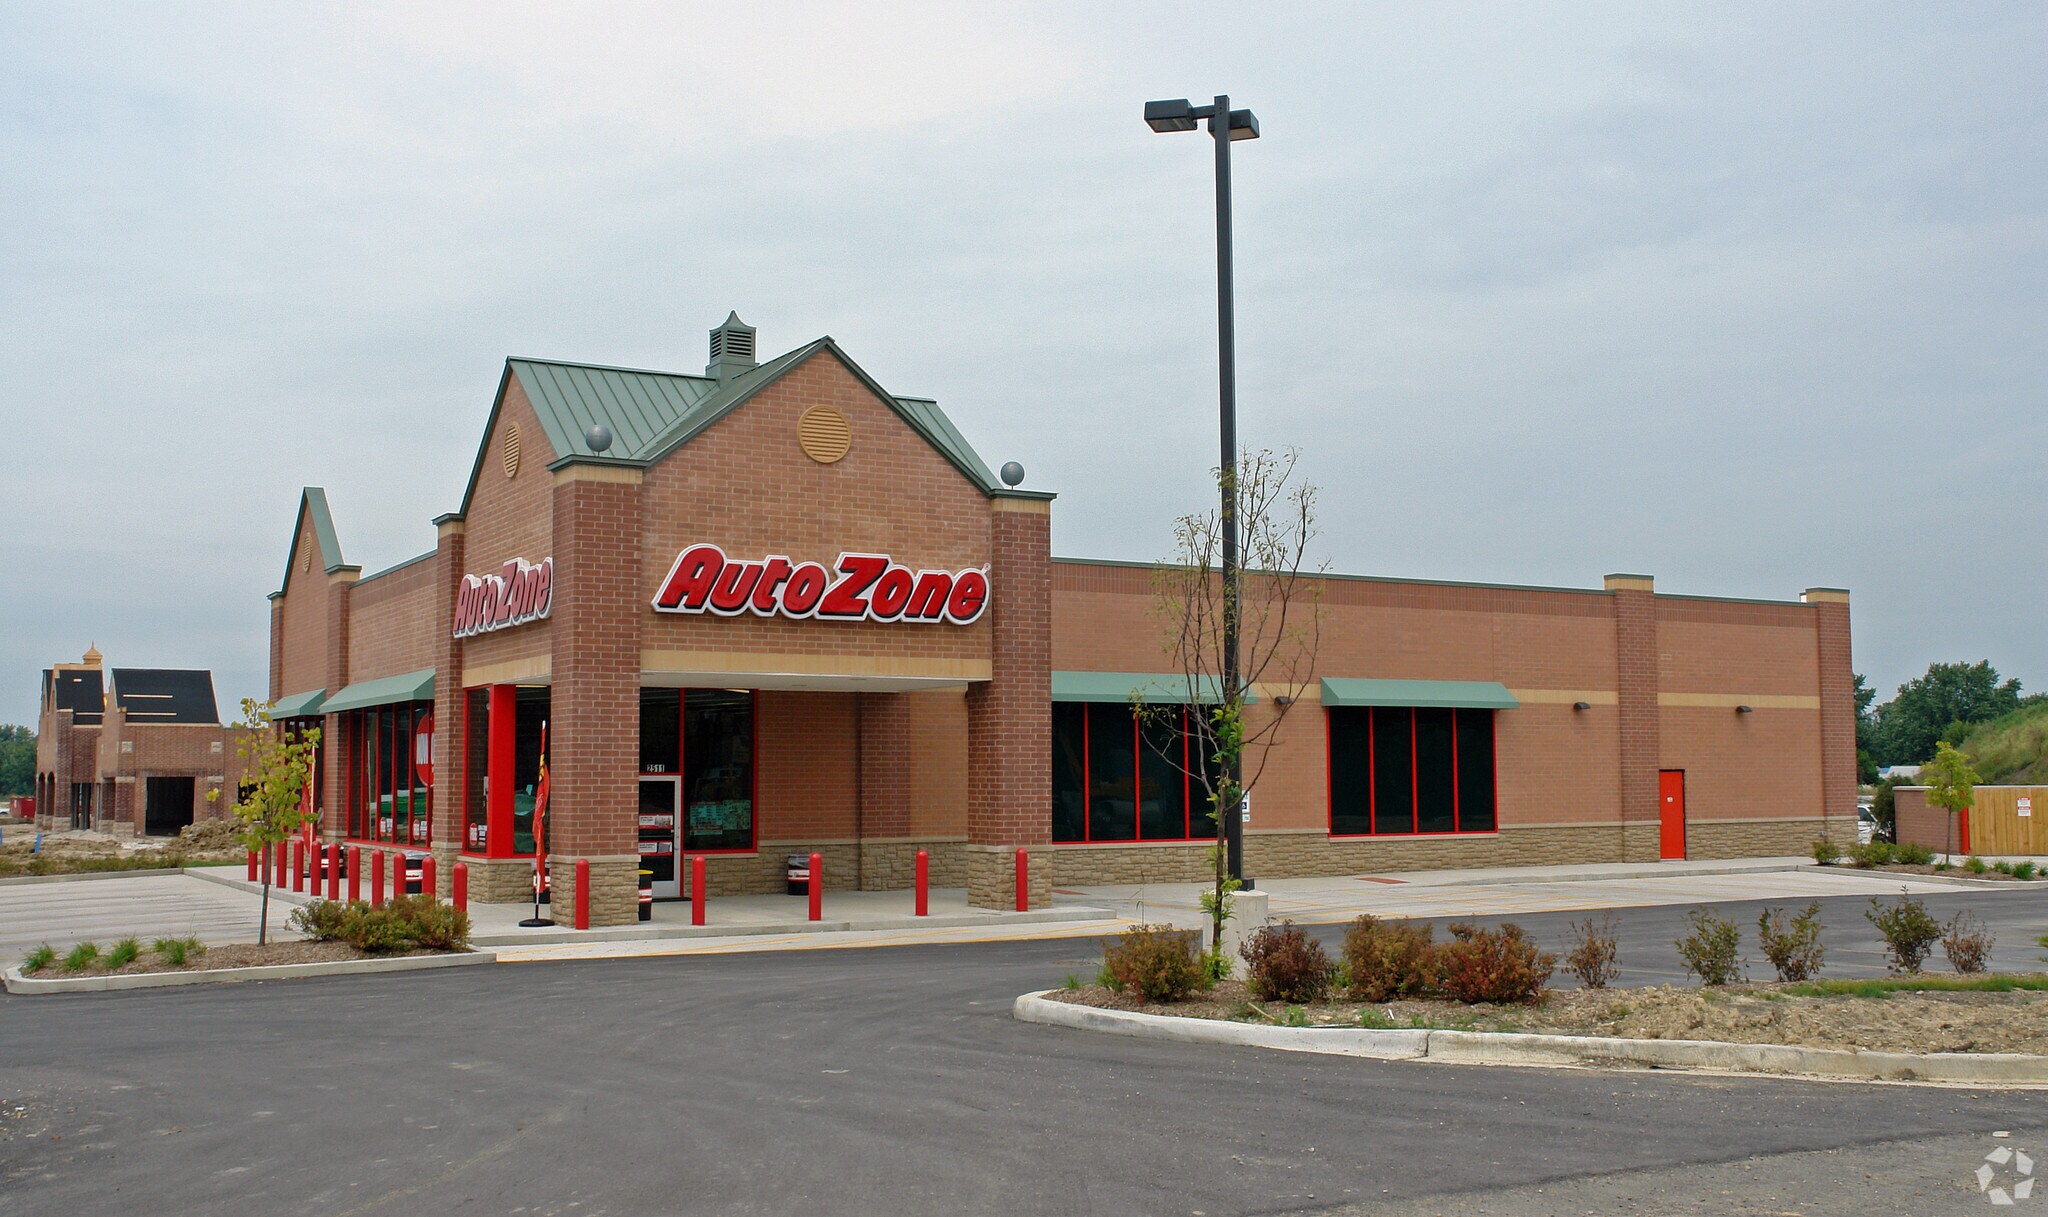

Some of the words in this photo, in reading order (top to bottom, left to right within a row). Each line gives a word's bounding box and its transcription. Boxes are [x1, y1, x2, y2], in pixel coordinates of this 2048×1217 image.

[453, 559, 552, 637] AutoZone
[656, 546, 989, 622] AutoZone
[646, 764, 665, 773] 2511
